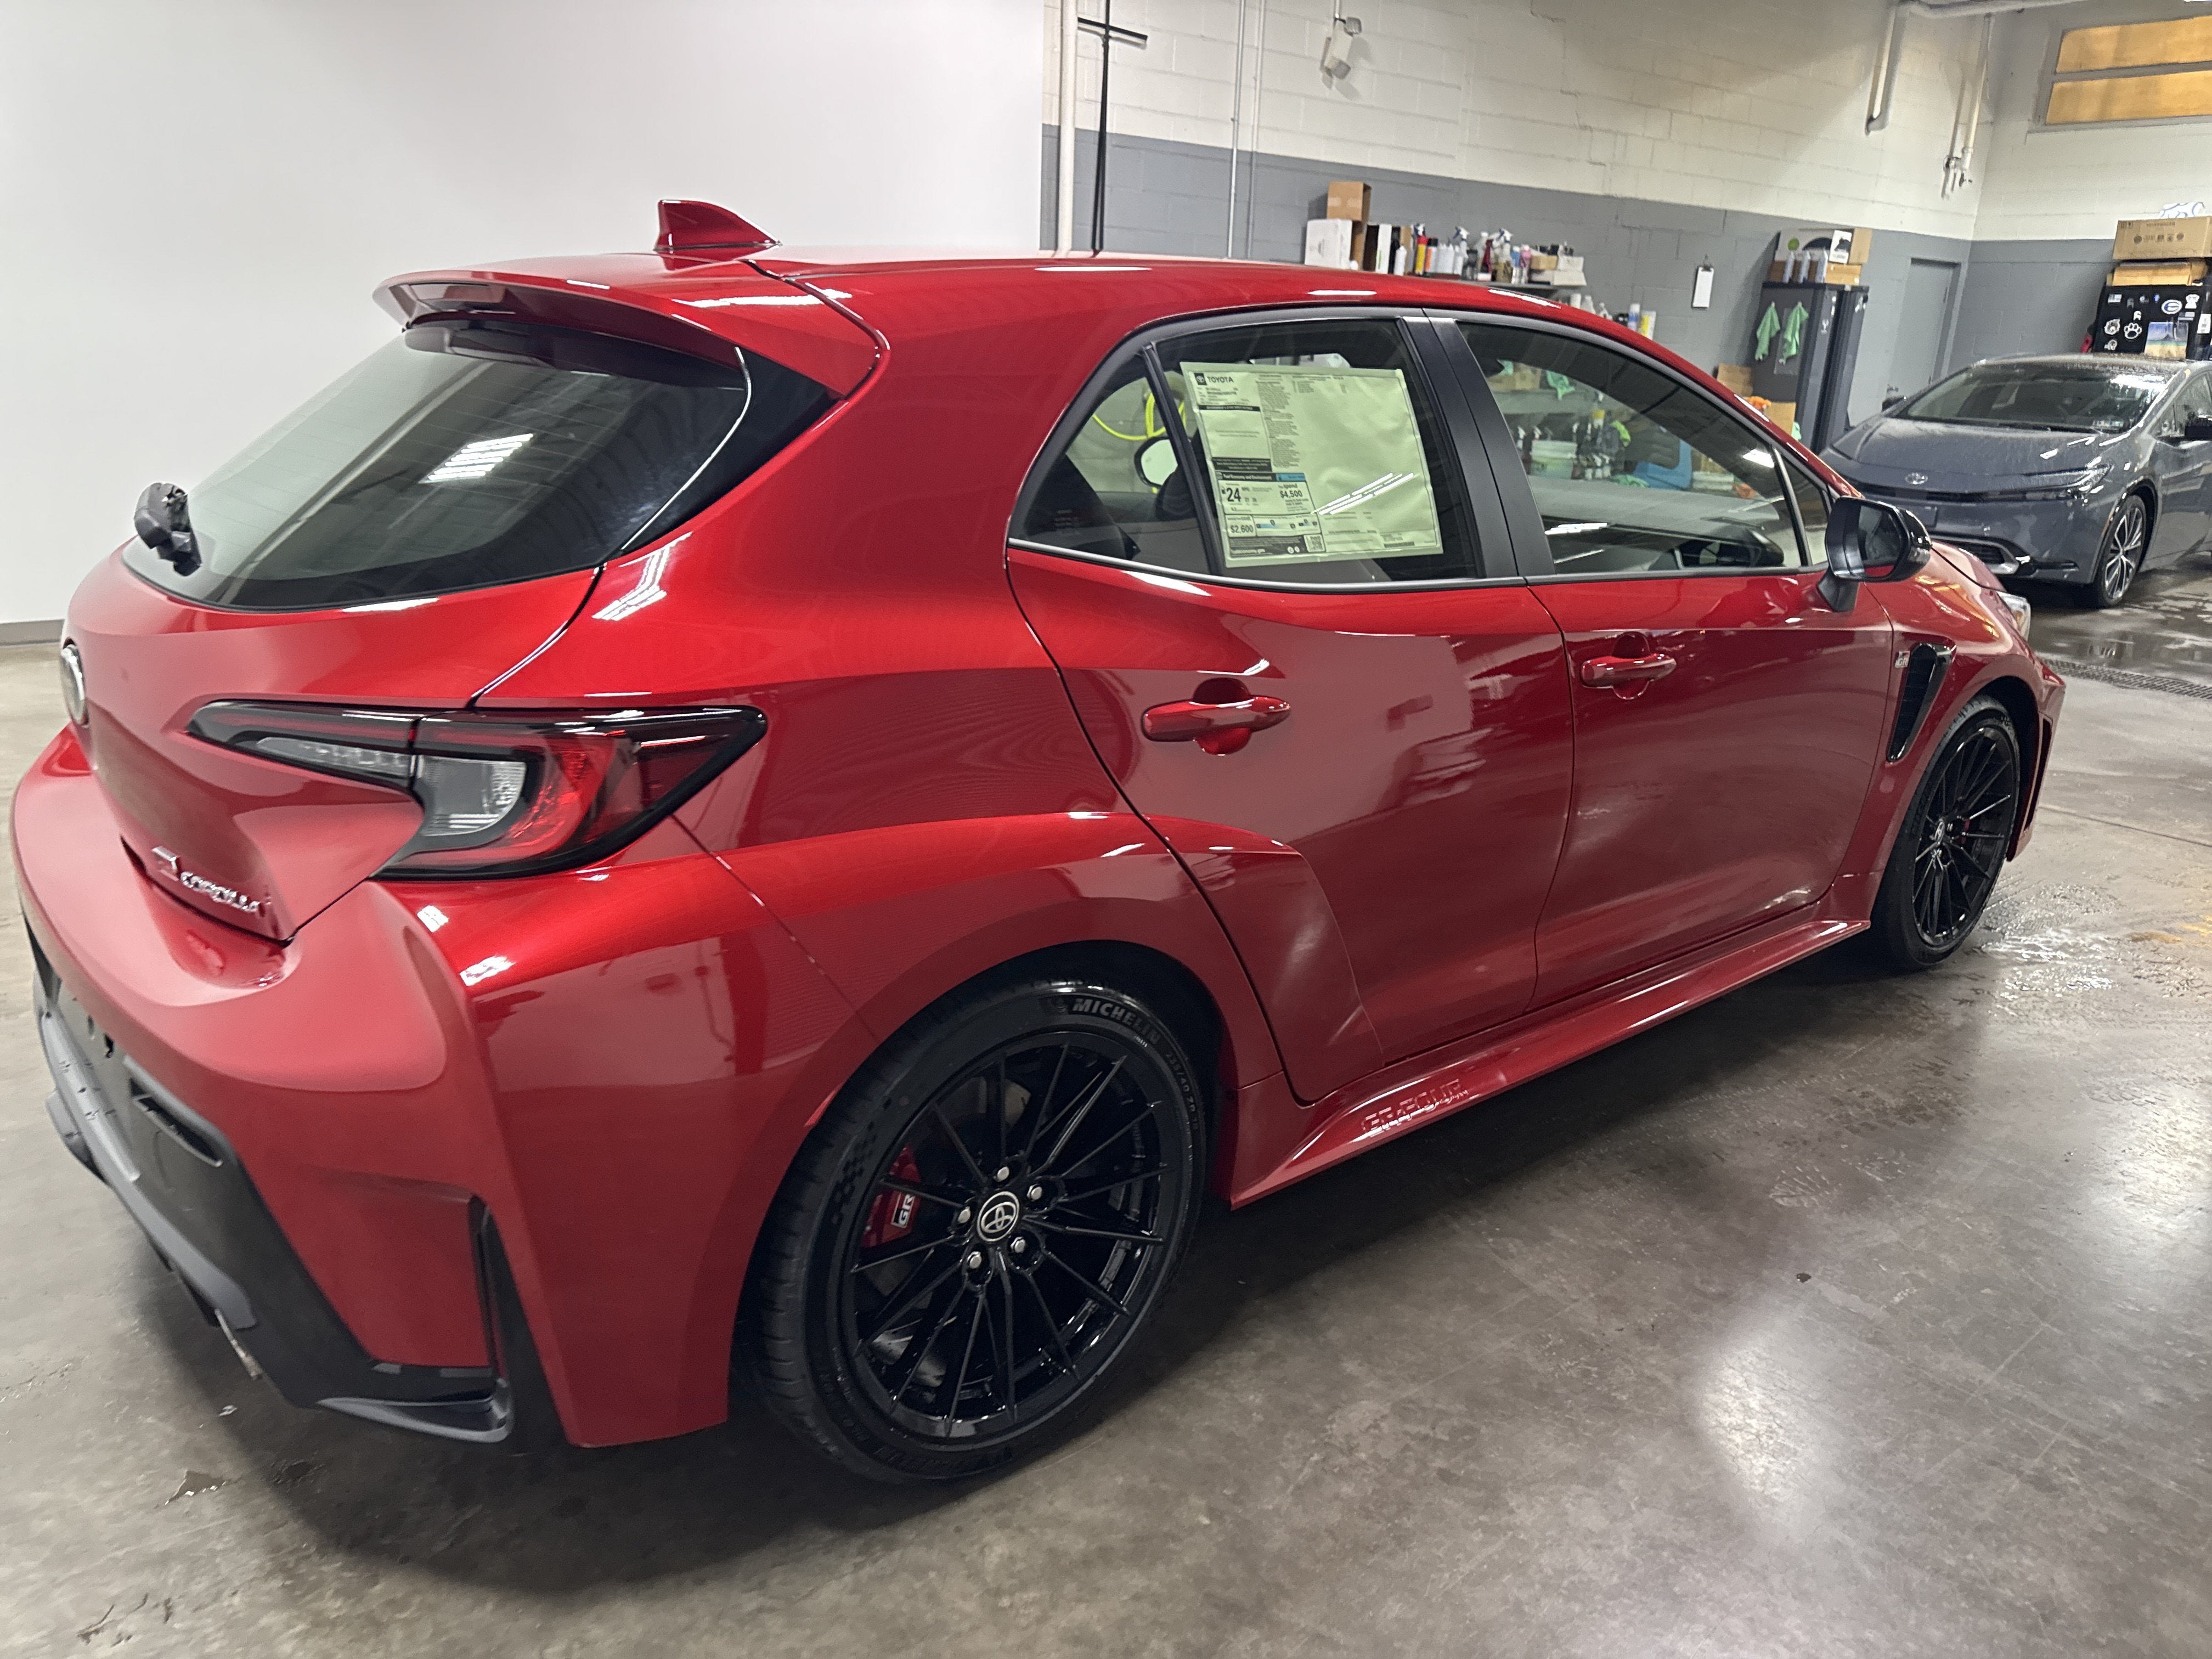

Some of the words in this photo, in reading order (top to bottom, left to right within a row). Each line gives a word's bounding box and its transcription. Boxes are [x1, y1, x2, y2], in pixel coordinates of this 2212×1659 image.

[1227, 488, 1241, 502] 24
[1280, 490, 1303, 499] $4,500
[1231, 525, 1254, 533] $2,600
[1072, 998, 1161, 1045] MICHELIN
[898, 1193, 915, 1226] GR
